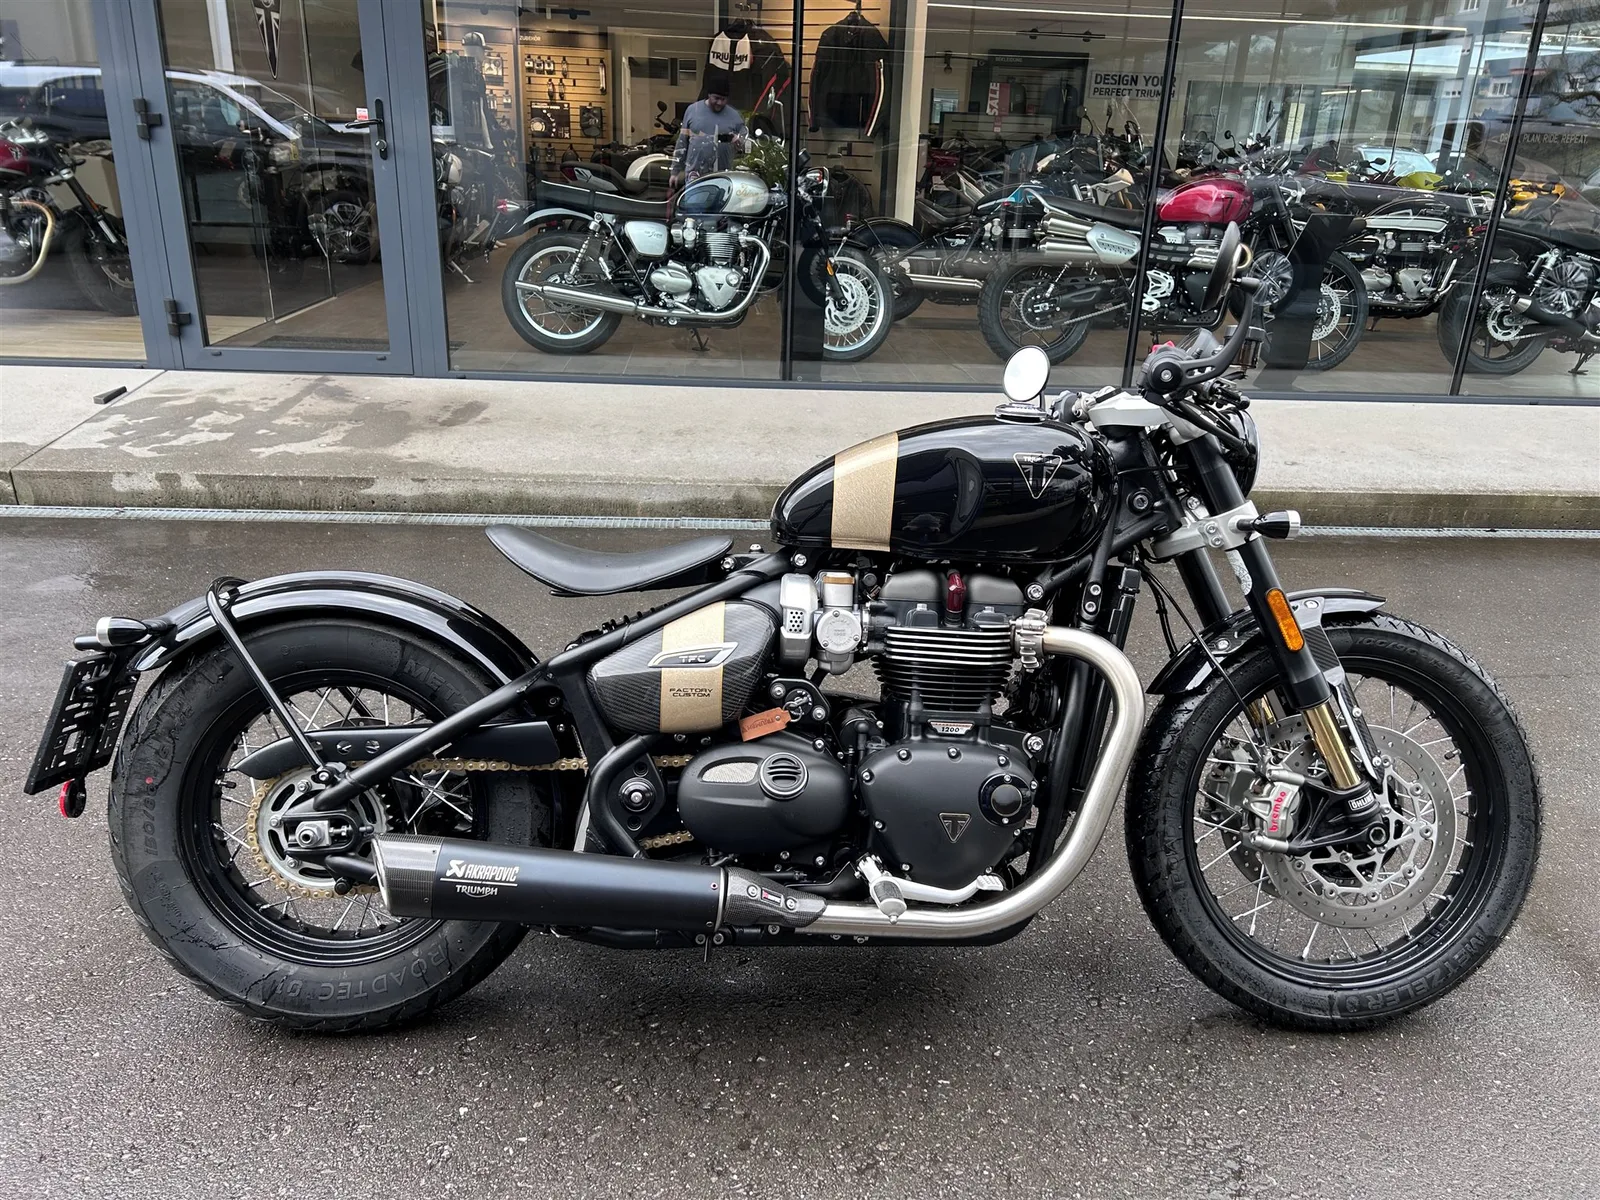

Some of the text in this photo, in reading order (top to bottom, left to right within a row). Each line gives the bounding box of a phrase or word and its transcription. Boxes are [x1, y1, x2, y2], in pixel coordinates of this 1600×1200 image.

[1094, 73, 1139, 86] DESIGN
[986, 82, 1000, 116] SALE
[1093, 87, 1175, 98] PERFECT TRIUMH
[678, 654, 706, 663] TFC
[1269, 791, 1286, 832] brembo
[455, 884, 499, 897] TRIUMPH
[317, 946, 448, 1001] ROADTEC
[1367, 925, 1488, 1011] METZELER
